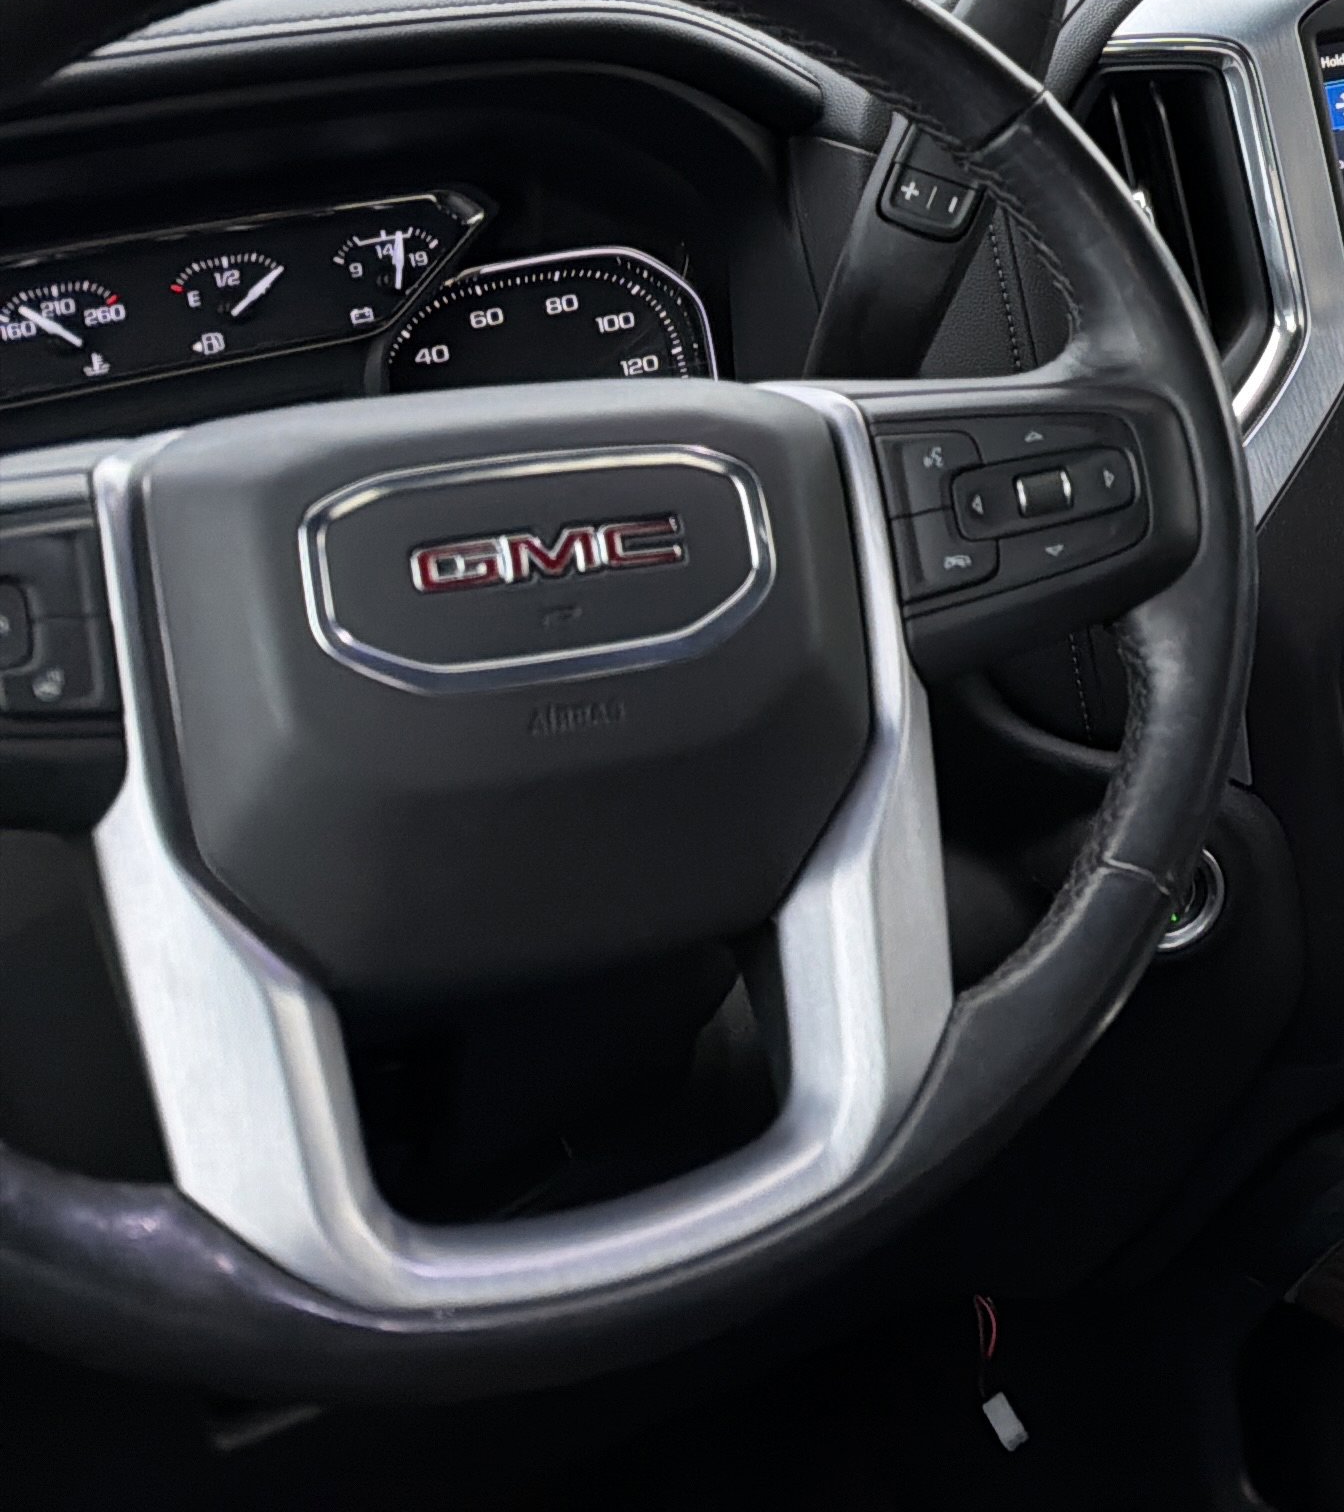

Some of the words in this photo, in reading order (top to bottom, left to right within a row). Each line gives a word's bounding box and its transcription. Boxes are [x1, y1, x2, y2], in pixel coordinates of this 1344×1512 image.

[409, 251, 428, 267] 19
[350, 263, 363, 278] 9
[187, 290, 202, 307] E
[546, 293, 579, 315] 80
[84, 304, 126, 327] 260
[469, 307, 504, 329] 60
[595, 312, 635, 334] 100
[0, 320, 37, 339] 160
[414, 344, 450, 365] 40
[620, 355, 659, 377] 120
[410, 515, 682, 592] GMC
